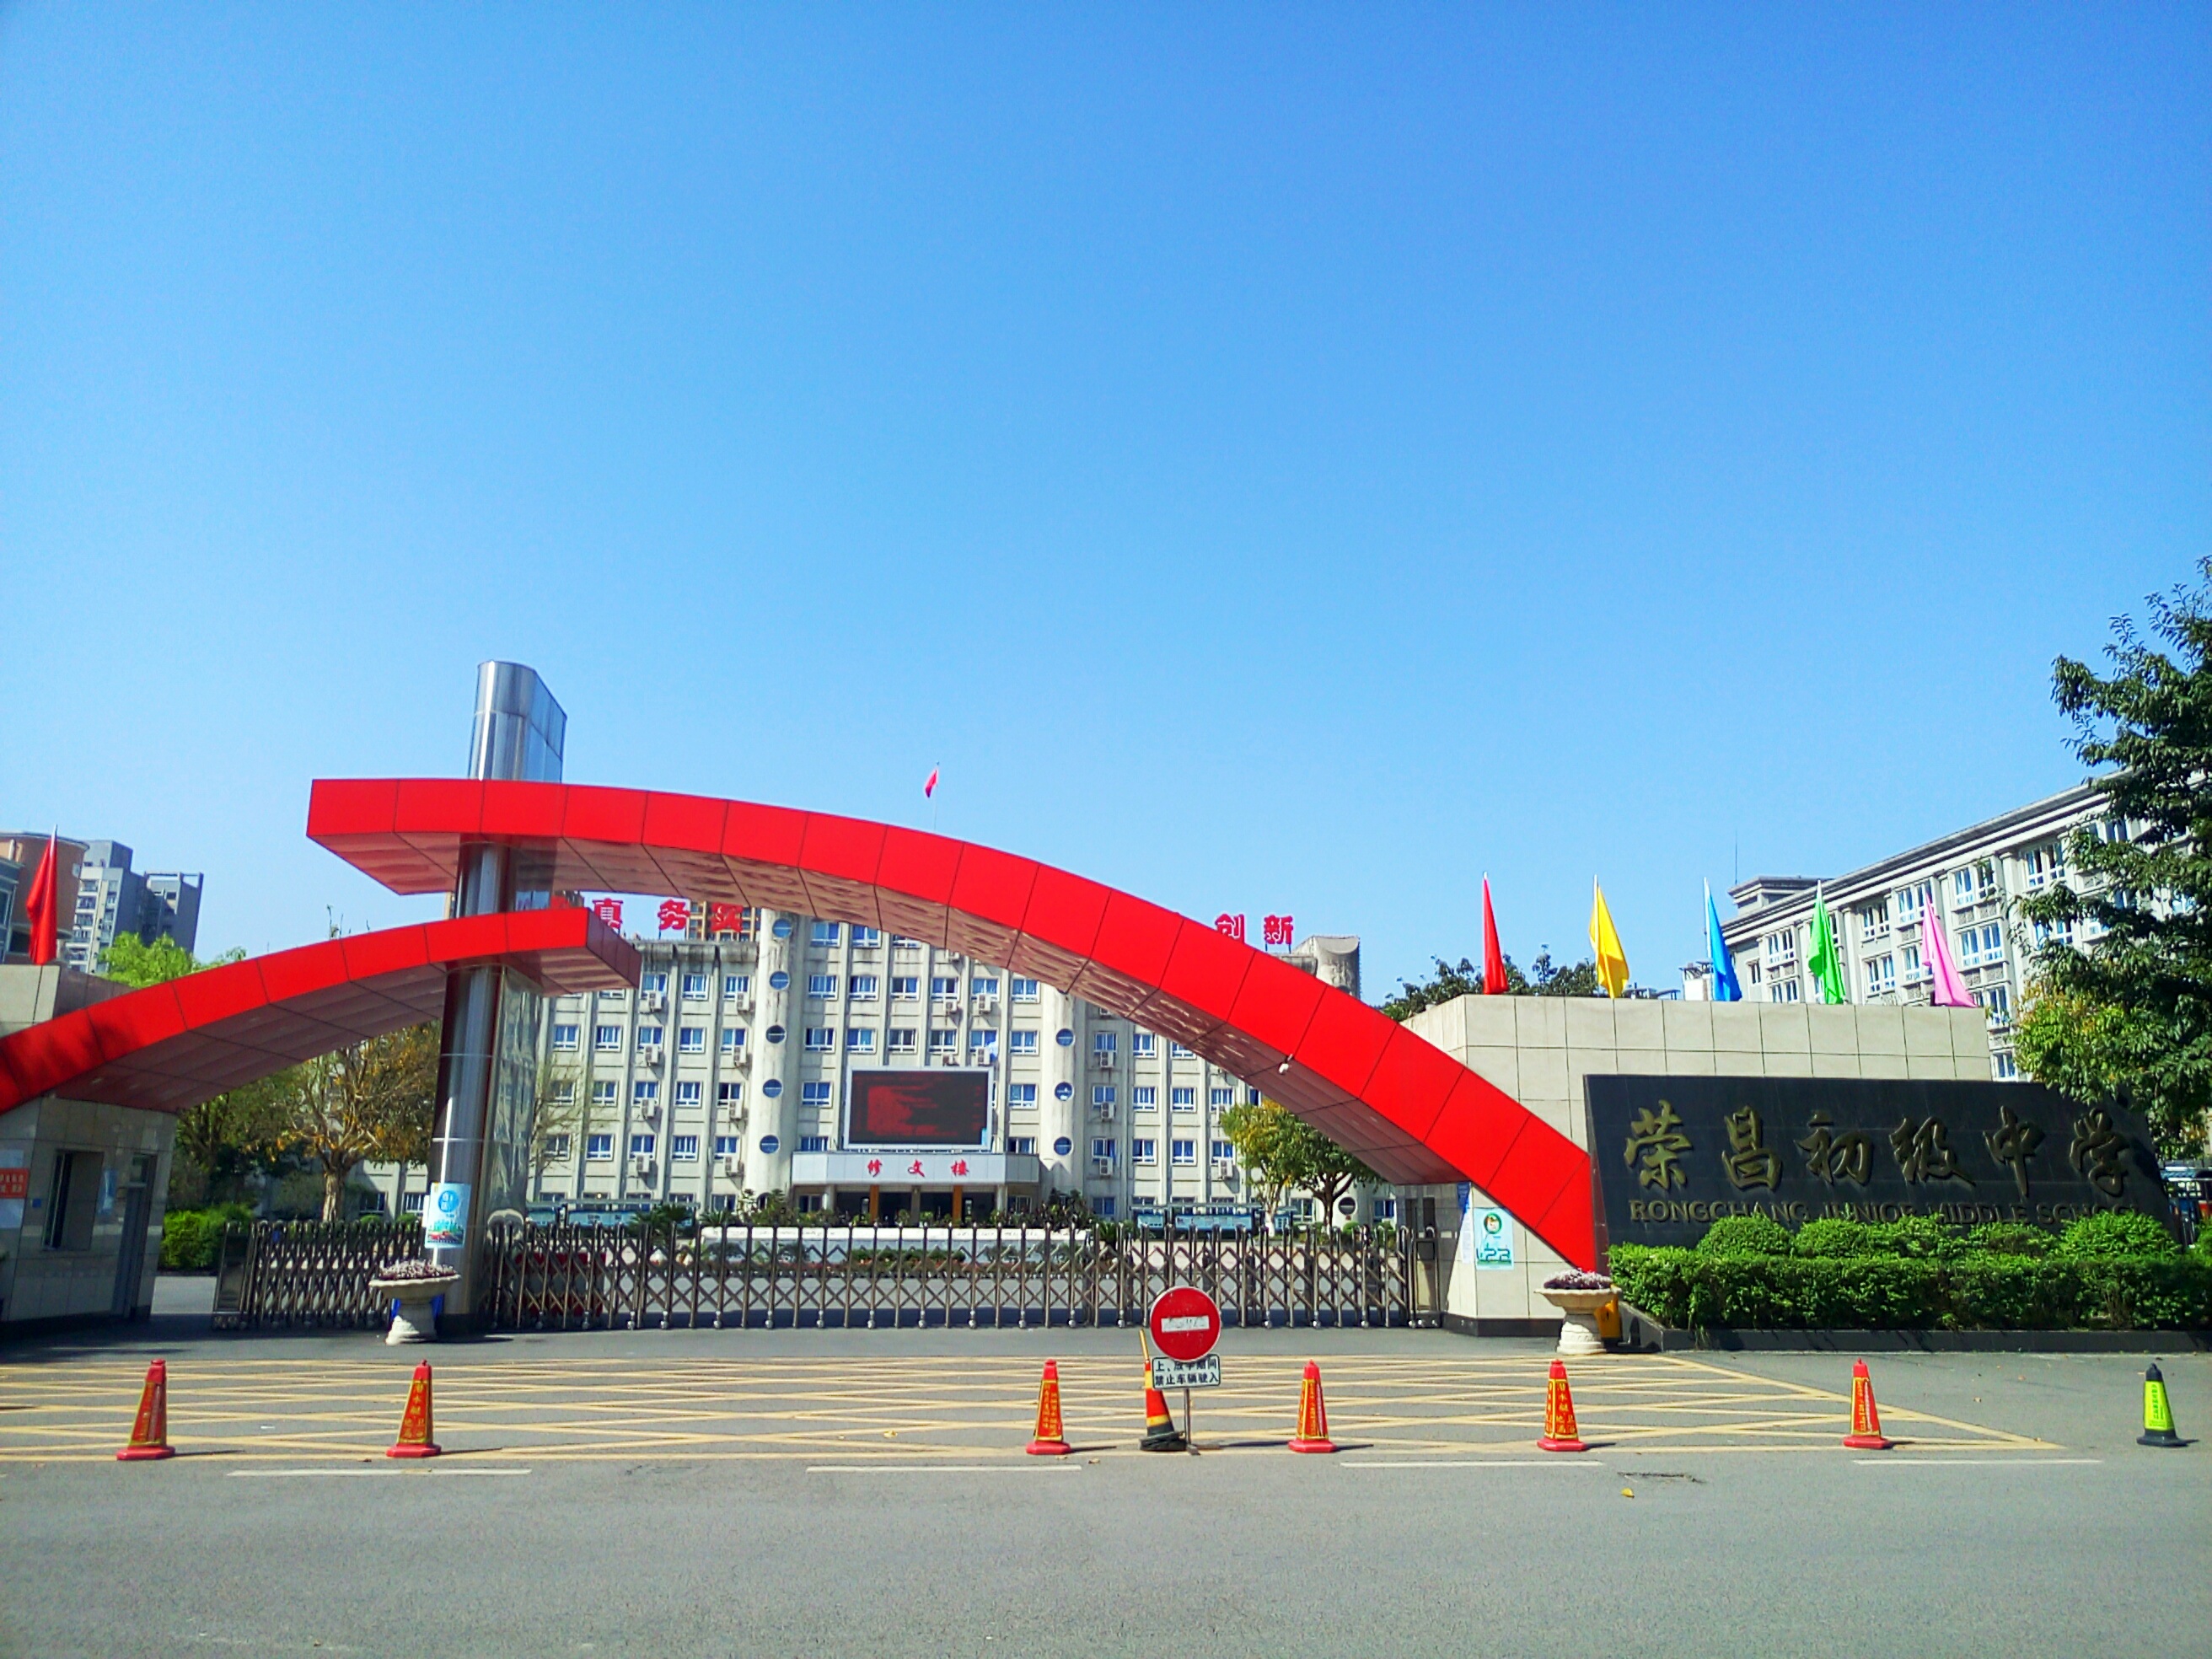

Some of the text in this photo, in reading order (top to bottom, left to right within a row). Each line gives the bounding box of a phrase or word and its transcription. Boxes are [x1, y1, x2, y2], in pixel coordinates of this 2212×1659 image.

[1214, 913, 1294, 945] 创新
[1624, 1098, 2131, 1198] 荣昌初级中学
[867, 1158, 969, 1178] 修文楼
[1628, 1199, 1810, 1223] RONGCHANG
[1156, 1372, 1219, 1386] 禁止车辆驶入
